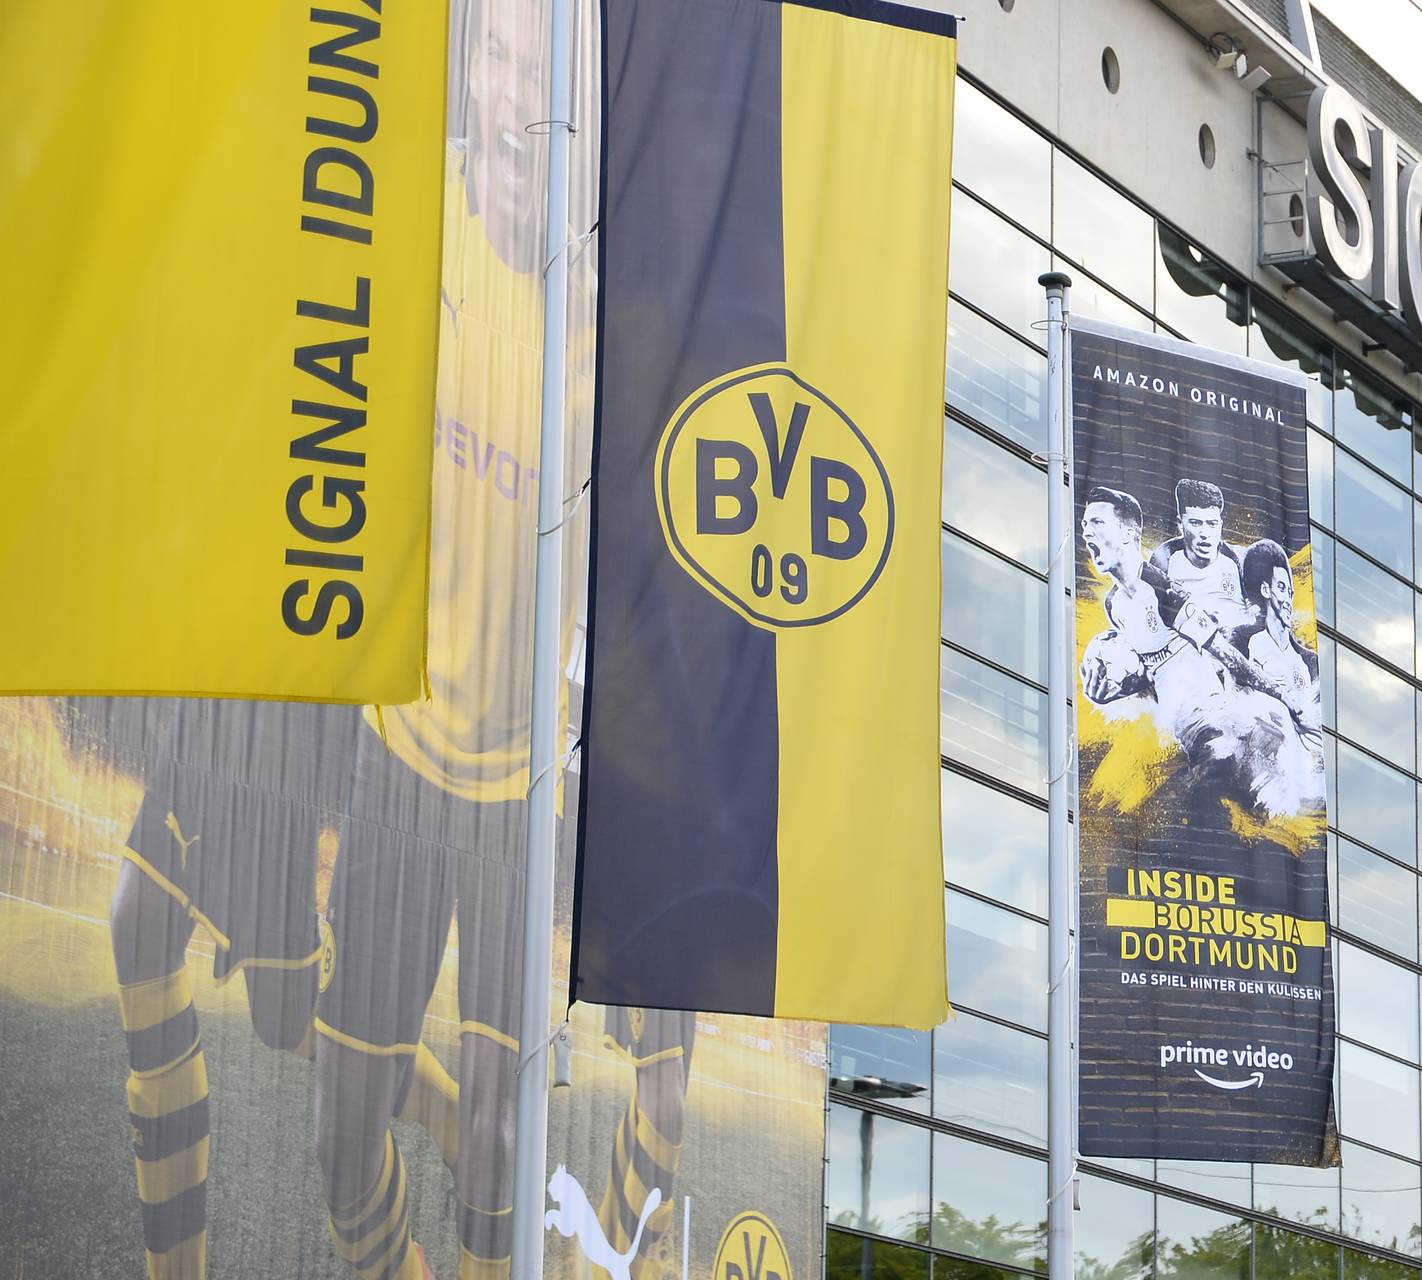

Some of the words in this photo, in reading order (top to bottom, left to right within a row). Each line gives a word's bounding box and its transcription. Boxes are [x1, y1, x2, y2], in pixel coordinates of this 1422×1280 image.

[300, 0, 382, 245] IDUN
[1093, 365, 1179, 397] AMAZON
[1190, 388, 1285, 426] ORIGINAL
[281, 276, 371, 640] SIGNAL
[696, 392, 868, 561] BVB
[751, 544, 808, 605] 09
[1127, 868, 1236, 905] INSIDE
[1156, 902, 1305, 946] BORUSSIA
[1120, 931, 1297, 974] DORTMUND
[1121, 972, 1147, 985] DAS
[1150, 973, 1187, 988] SPIEL
[1190, 977, 1236, 992] HINTER
[1239, 981, 1264, 994] DEN
[1268, 983, 1322, 1000] KULISSEN
[1160, 1040, 1228, 1067] prime
[1232, 1045, 1293, 1070] video
